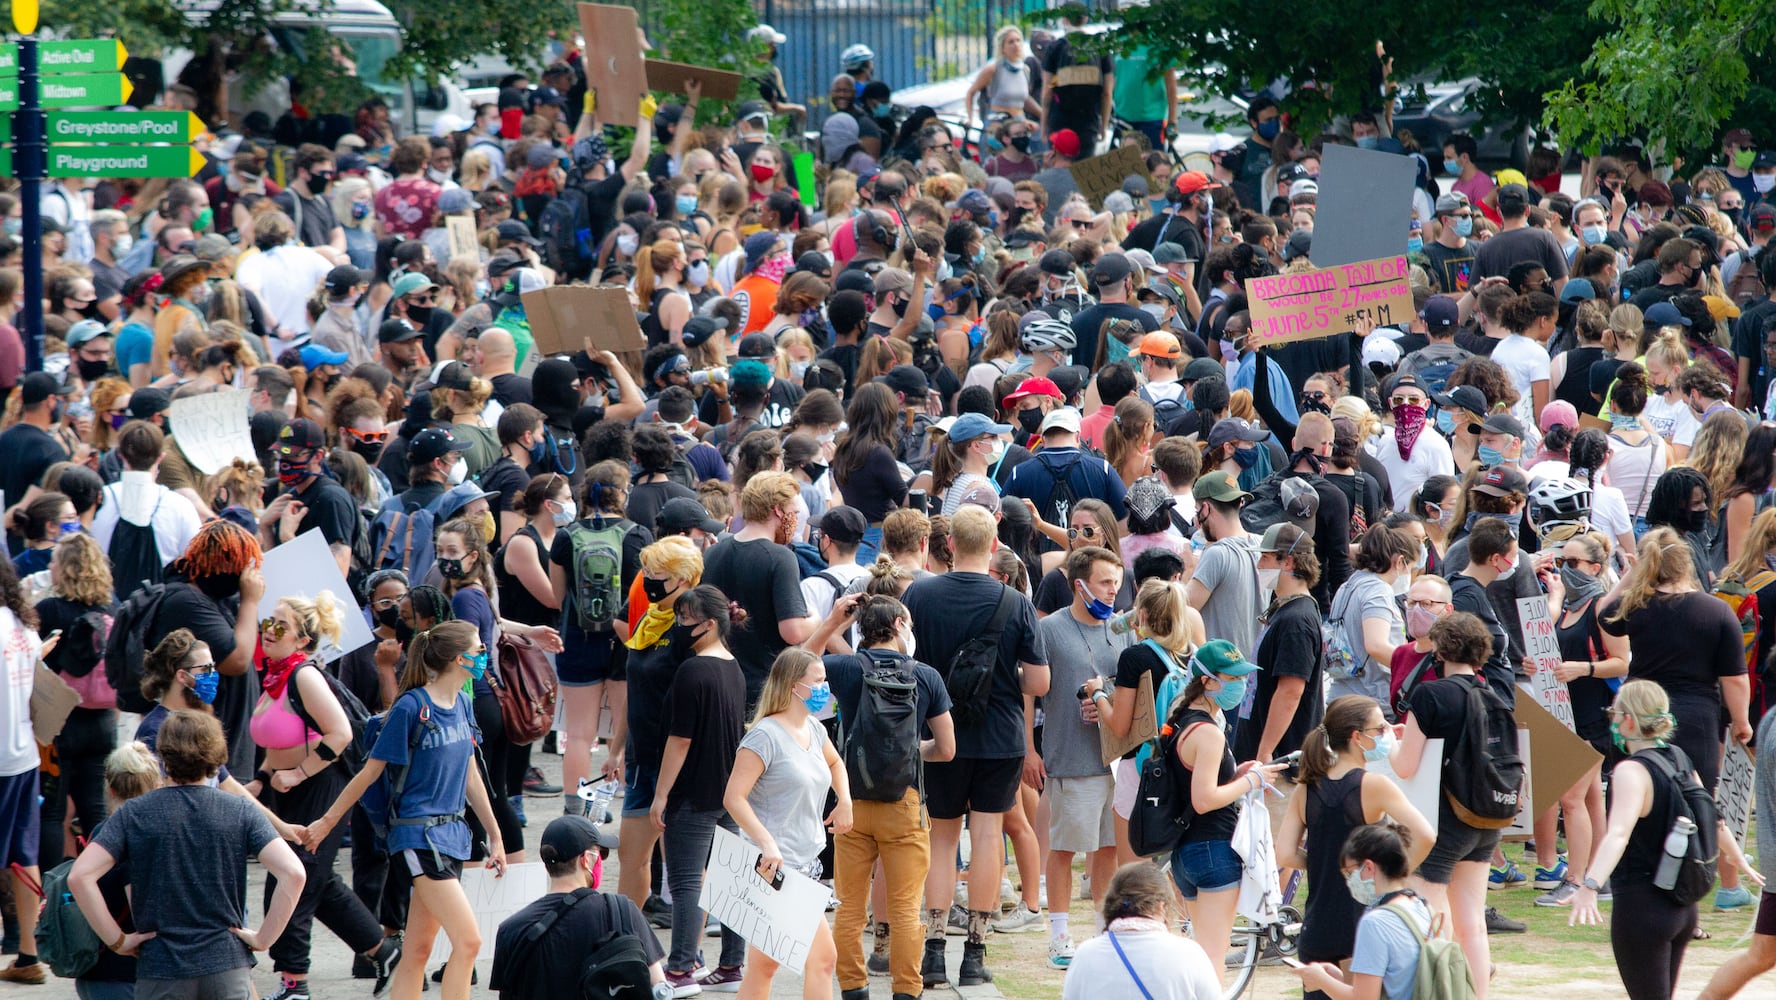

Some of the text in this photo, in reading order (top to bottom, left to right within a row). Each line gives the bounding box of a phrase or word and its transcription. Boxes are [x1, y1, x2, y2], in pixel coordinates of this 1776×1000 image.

[42, 49, 94, 64] Active Oval
[42, 84, 86, 98] Midtown
[56, 119, 178, 136] Greystone/Pool
[56, 154, 148, 171] Playground
[1341, 257, 1409, 286] TAYLOR
[1267, 294, 1312, 308] WOULD
[1340, 286, 1361, 308] 27
[1524, 599, 1549, 621] VOTE
[1531, 636, 1561, 656] VOTE
[1715, 746, 1737, 820] BLACK
[1728, 759, 1744, 823] LIVES
[1734, 761, 1754, 842] MATTER
[708, 882, 808, 971] VIOLENCE
